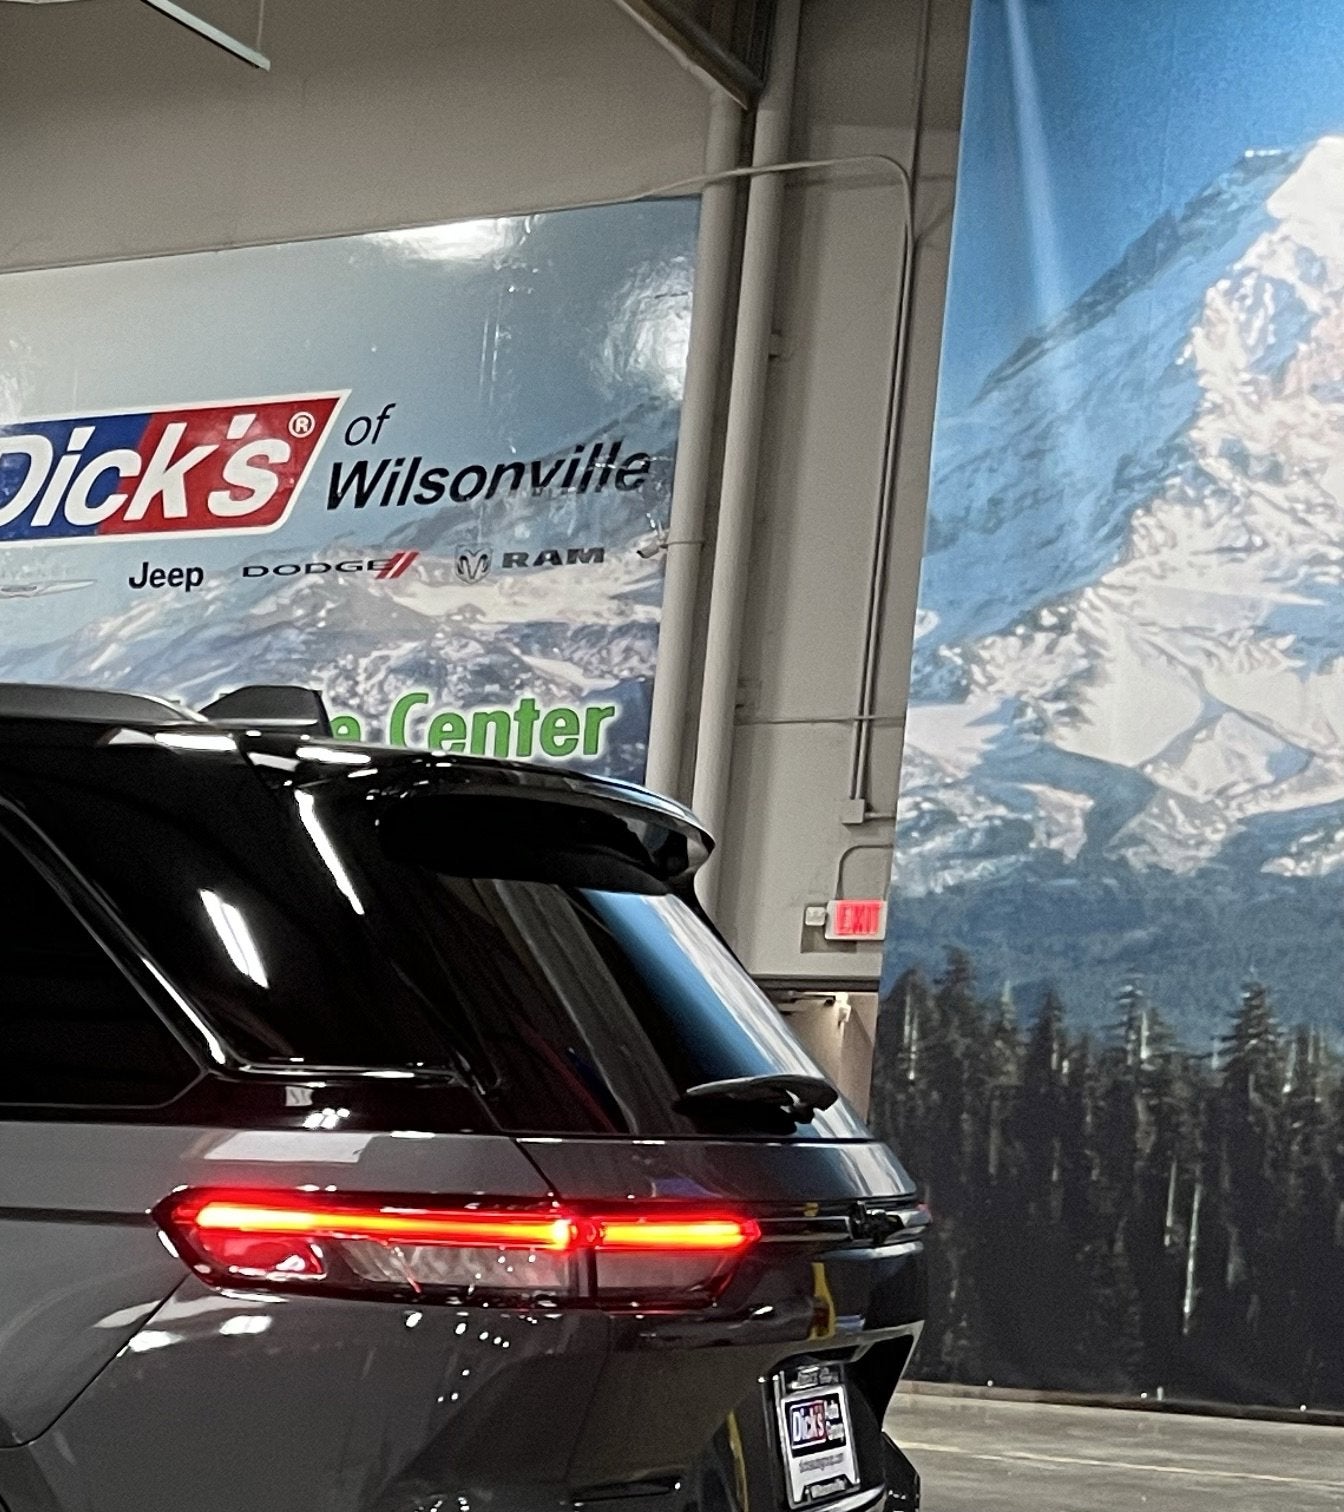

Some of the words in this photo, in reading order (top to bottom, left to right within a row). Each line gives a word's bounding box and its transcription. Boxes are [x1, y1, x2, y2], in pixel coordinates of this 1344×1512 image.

[344, 403, 396, 446] of
[326, 439, 651, 510] Wilsonville
[241, 558, 396, 578] DODGE
[502, 547, 606, 570] RAM
[128, 562, 204, 592] Jeep
[389, 692, 615, 758] Center
[838, 904, 881, 935] EXIT
